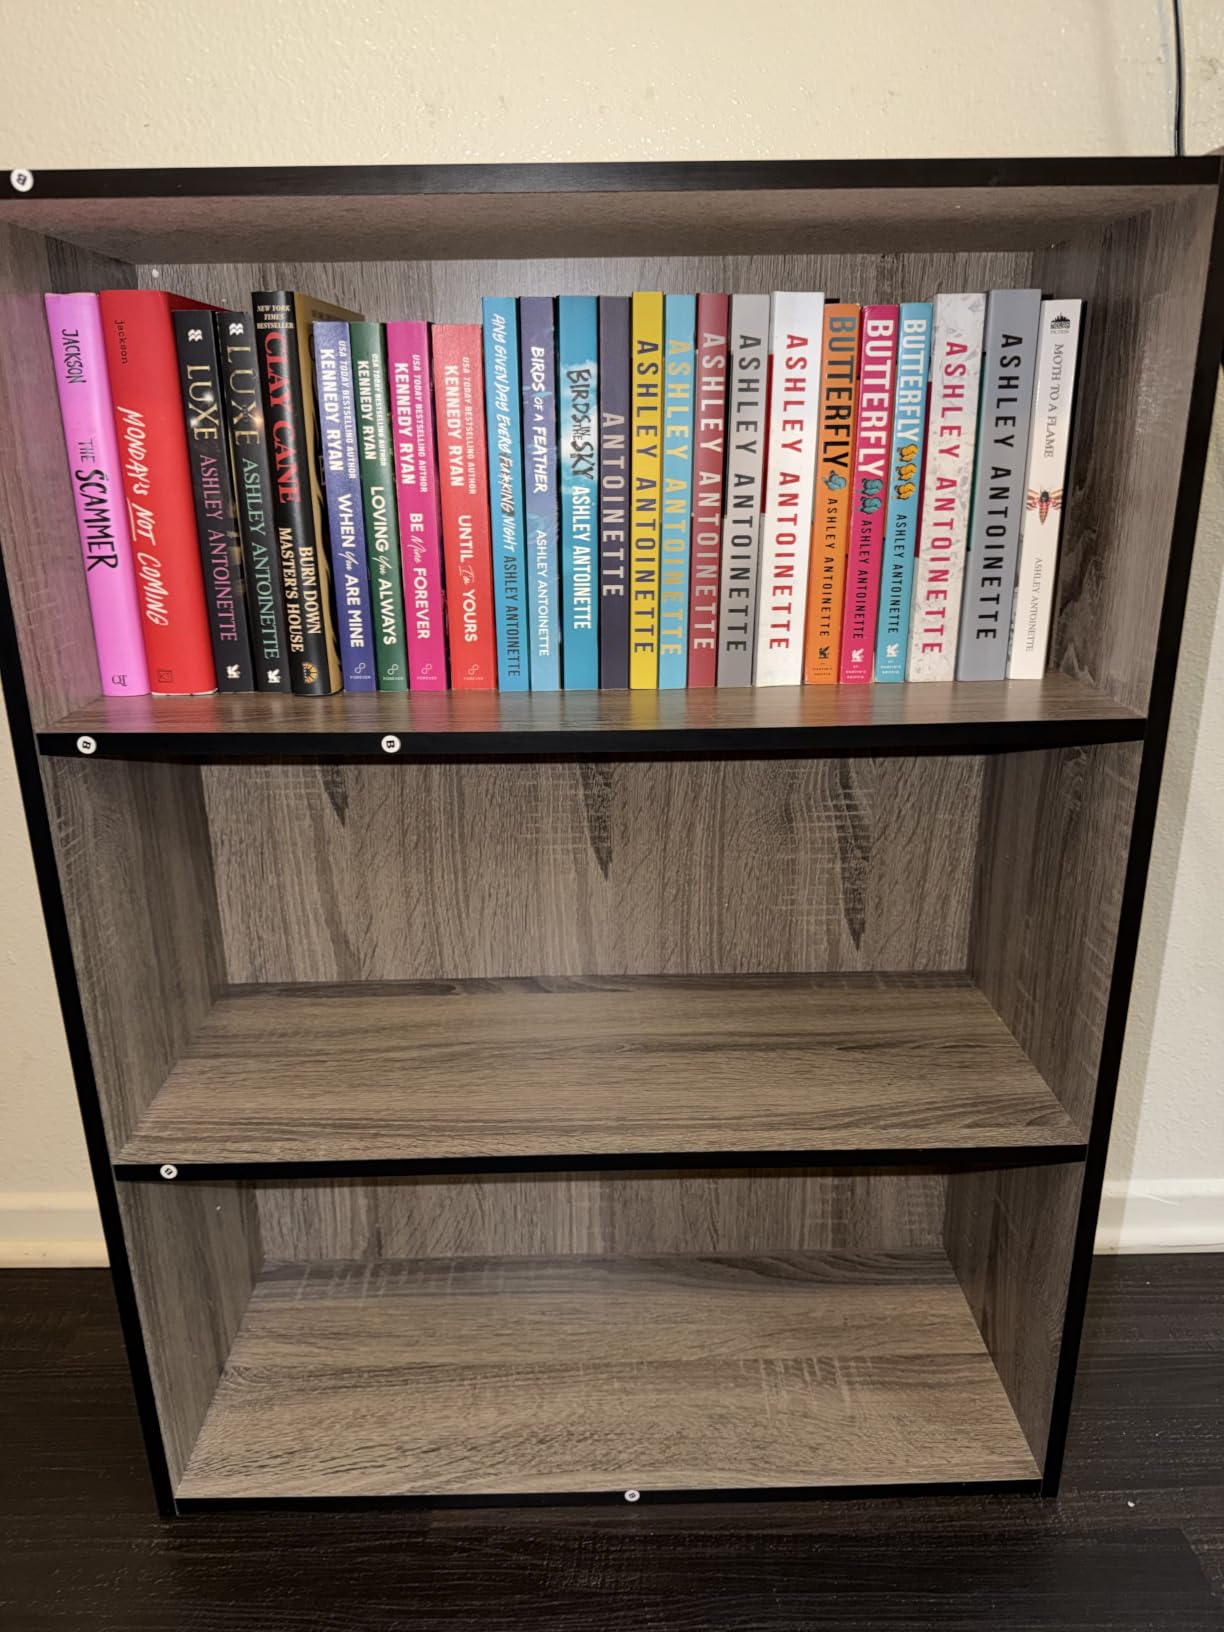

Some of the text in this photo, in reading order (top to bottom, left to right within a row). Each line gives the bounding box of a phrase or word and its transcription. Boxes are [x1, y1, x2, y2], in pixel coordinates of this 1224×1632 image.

[61, 328, 87, 384] JACKSON
[256, 322, 294, 330] BESTSELLER
[491, 313, 508, 343] ANY
[493, 345, 510, 382] GIVEN
[1051, 343, 1064, 381] MOTH
[264, 331, 301, 503] CLAY CANE
[319, 348, 344, 472] KENNEDY RYAN
[338, 340, 357, 480] USA TODAY BESTSELLING AUTHOR
[357, 360, 377, 460] KENNEDY RYAN
[394, 362, 416, 485] KENNEDY RYAN
[411, 354, 428, 493] USA TODAY BESTSELLING AUTHOR
[444, 365, 465, 487] KENNEDY RYAN
[462, 356, 477, 495] USA TODAY BESTSELLING AUTHOR
[493, 382, 510, 412] DAY
[566, 368, 592, 423] BIRDS
[1048, 403, 1058, 412] A
[1049, 385, 1061, 401] TO
[496, 414, 512, 454] EVERY
[570, 441, 596, 480] SKY
[1044, 415, 1057, 458] FLAME
[75, 437, 119, 572] THE SCAMMER
[187, 364, 238, 641] LUXE ASHLEY ANTOINETTE
[227, 345, 280, 660] LUXE ASHLEY ANTOINETTE
[529, 346, 550, 657] BIRDS OF A FEATHER ASHLEY ANTOINETTE
[572, 485, 591, 541] ASHLEY
[602, 412, 625, 597] ANTOINETTE
[634, 340, 659, 653] ASHLEY ANTOINETTE
[660, 338, 691, 656] ASHLEY ANTOINETTE
[693, 332, 726, 650] ASHLEY ANTOINETTE
[726, 334, 761, 652] ASHLEY ANTOINETTE
[769, 334, 808, 649] ASHLEY ANTOINETTE
[819, 316, 857, 637] BUTTERFLY ASHLEY ANTOINETTE
[852, 319, 894, 640] BUTTERFLY ASHLEY ANTOINETTE
[887, 319, 926, 634] BUTTERFLY ASHLEY ANTOINETTE
[921, 341, 968, 654] ASHLEY ANTOINETTE
[975, 334, 1023, 640] ASHLEY ANTOINETTE
[117, 406, 169, 626] MONDAY'S NOT COMING
[337, 493, 356, 547] WHEN
[369, 486, 389, 552] LOVING
[409, 513, 424, 532] BE
[458, 515, 473, 563] UNTIL
[502, 515, 518, 552] NIGHT
[279, 527, 305, 653] MASTER'S HOUSE
[298, 546, 322, 634] BURN DOWN
[344, 574, 361, 606] ARE
[377, 578, 397, 645] ALWAYS
[412, 567, 431, 639] FOREVER
[503, 556, 518, 601] ASHLEY
[573, 545, 592, 629] ANTOINETTE
[1032, 557, 1043, 594] ASHLEY
[347, 609, 365, 648] MINE
[463, 589, 478, 642] YOURS
[505, 605, 521, 677] ANTOINETTE
[1025, 595, 1039, 652] ANTOINETTE
